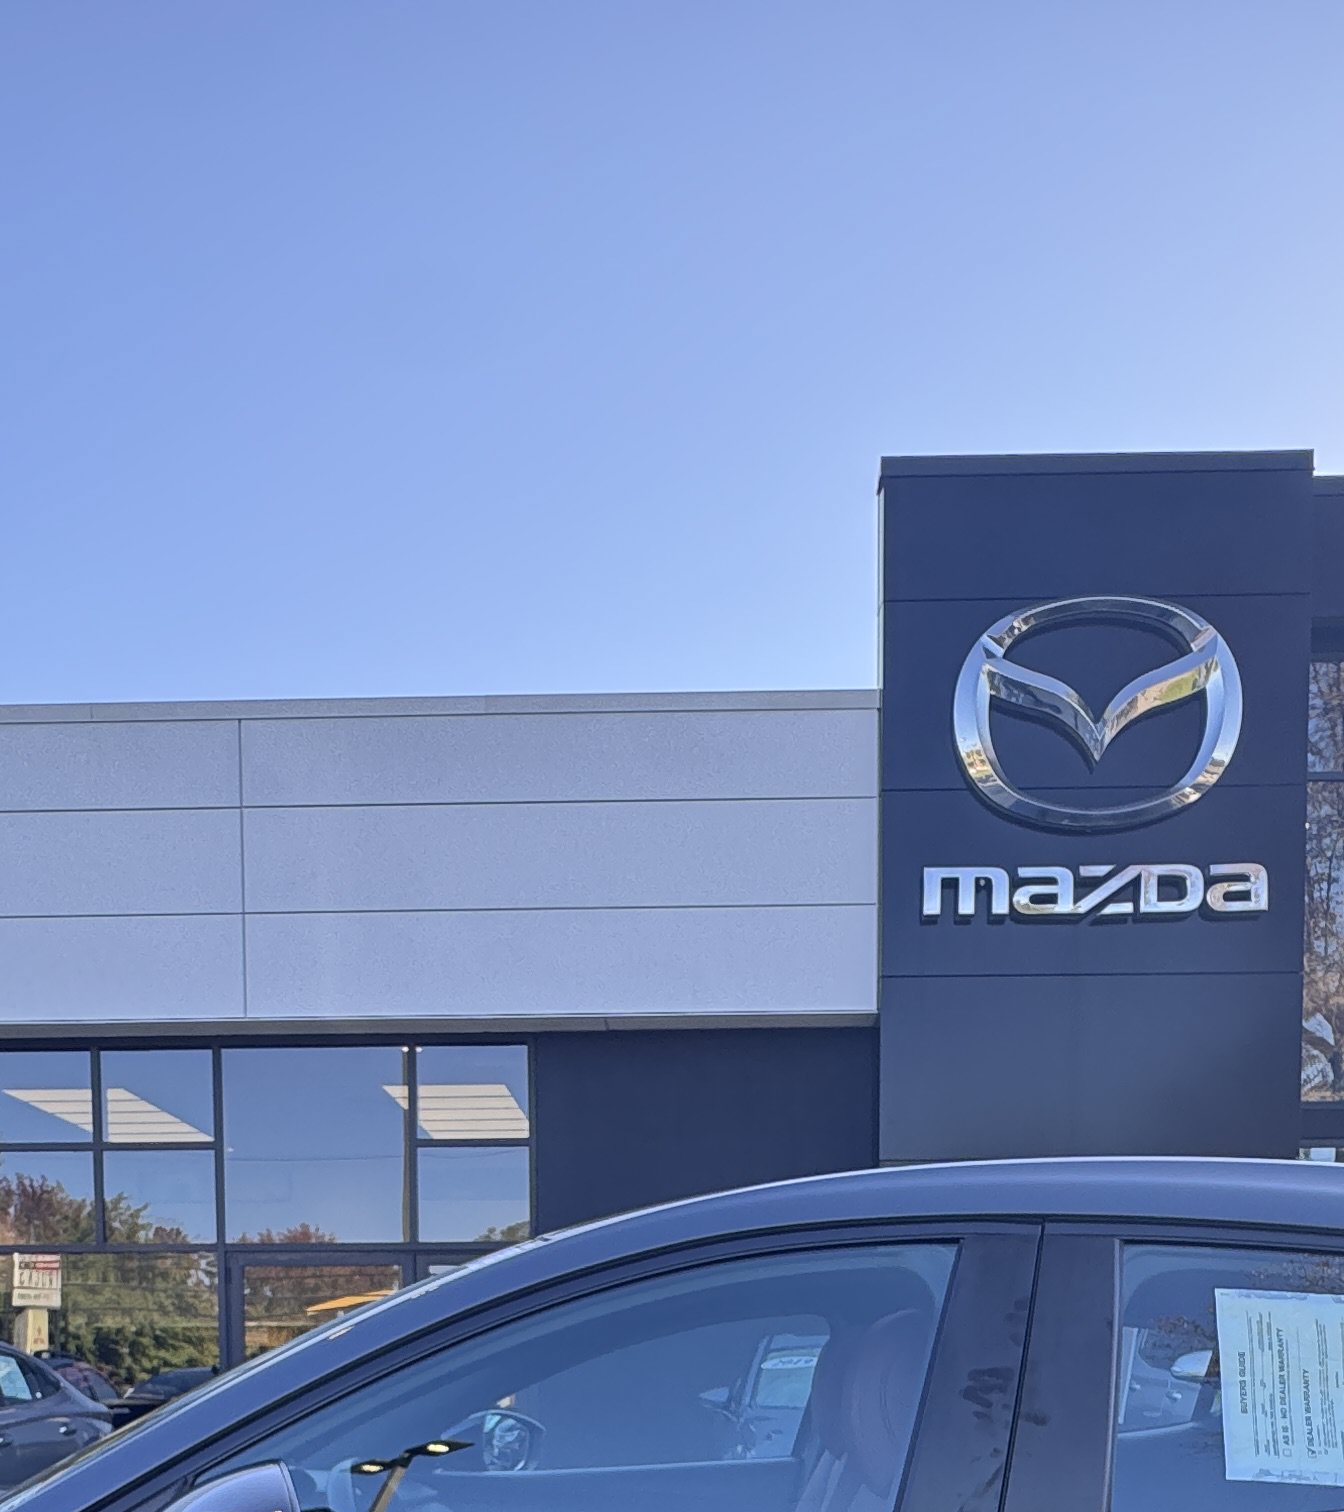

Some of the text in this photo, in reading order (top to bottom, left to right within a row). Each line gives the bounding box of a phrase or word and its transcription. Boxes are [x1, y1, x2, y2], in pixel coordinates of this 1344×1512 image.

[1276, 1327, 1285, 1372] WARRANTY
[1278, 1374, 1287, 1406] DEALER
[1302, 1369, 1314, 1447] DEALER WARRANTY
